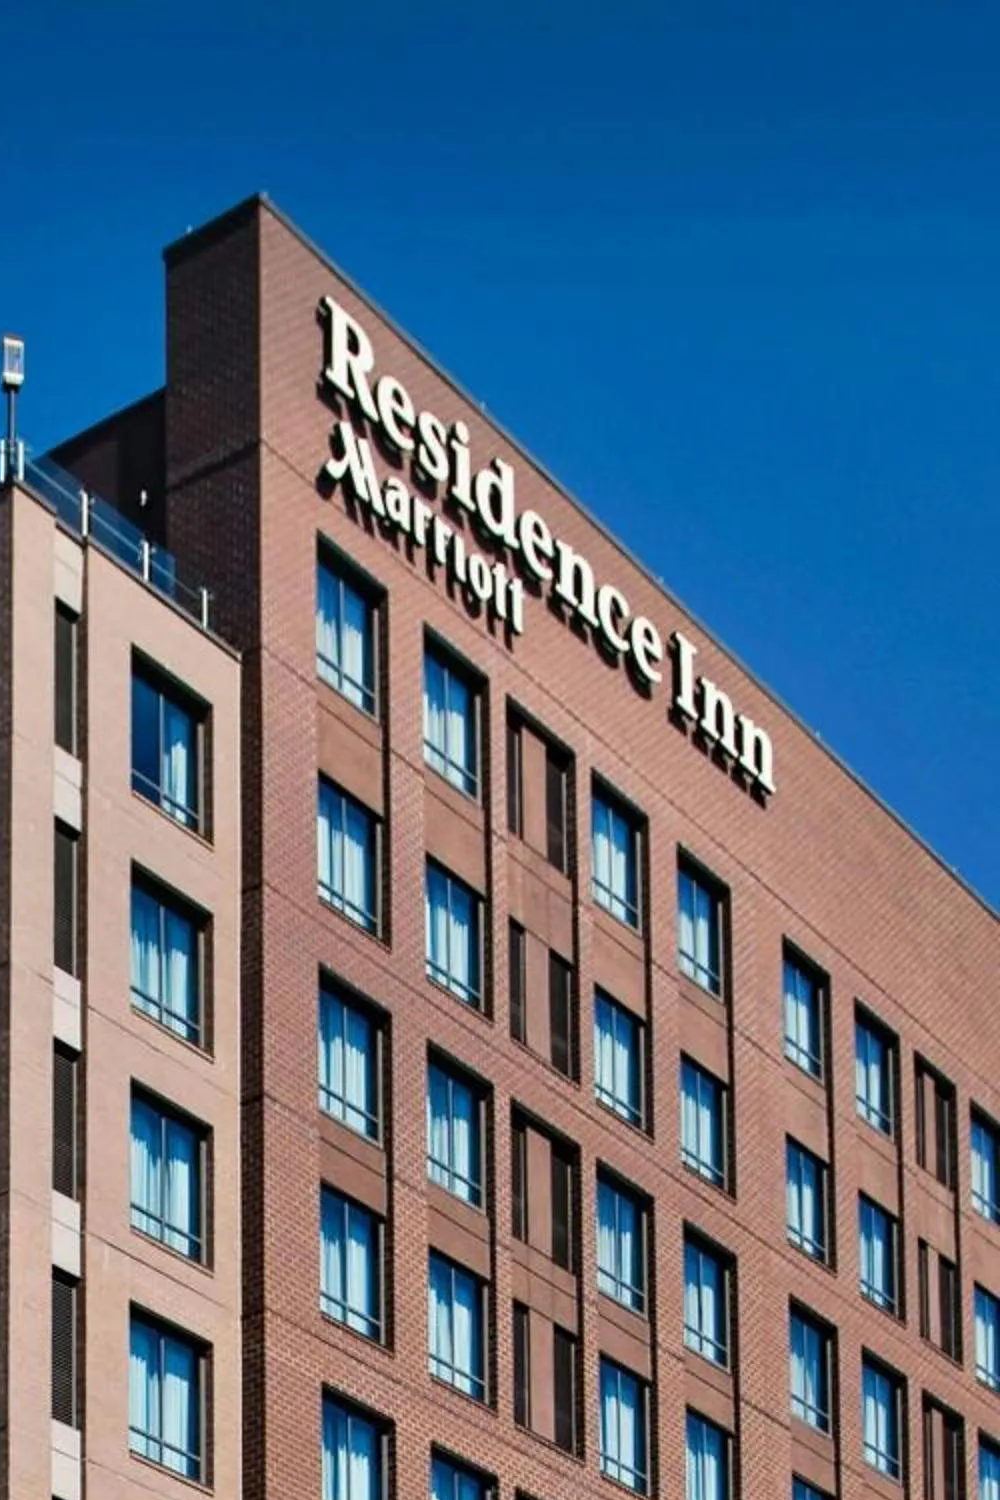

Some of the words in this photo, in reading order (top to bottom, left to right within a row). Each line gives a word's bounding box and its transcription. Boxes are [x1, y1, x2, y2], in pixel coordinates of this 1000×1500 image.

[324, 296, 663, 684] Residence
[671, 632, 777, 795] Inn
[326, 421, 525, 634] Marriott
